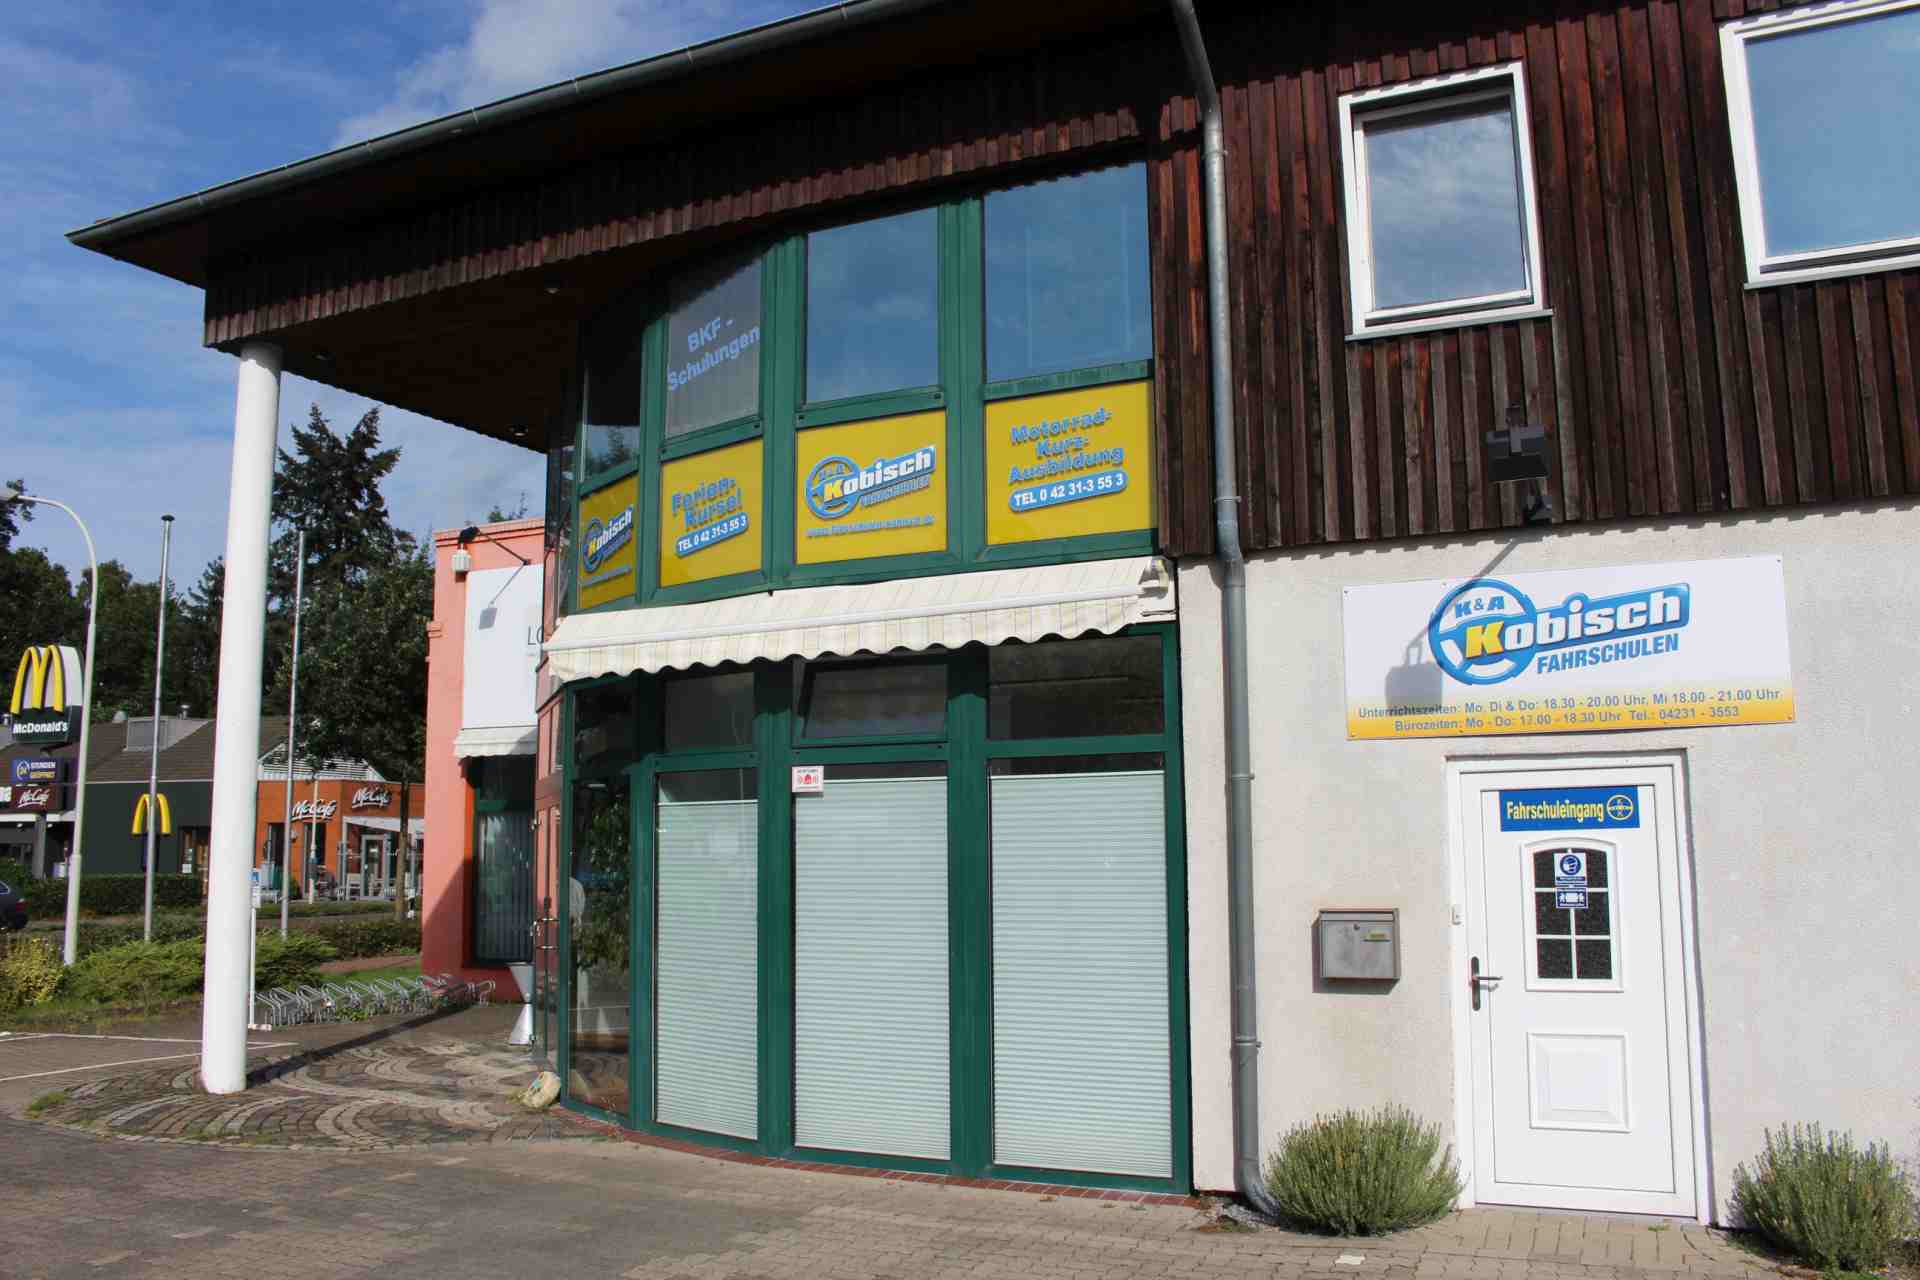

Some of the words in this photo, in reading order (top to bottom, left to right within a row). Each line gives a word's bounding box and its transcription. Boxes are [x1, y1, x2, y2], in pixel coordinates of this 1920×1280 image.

[688, 317, 721, 353] BKF
[668, 326, 761, 391] Schulungen
[1010, 408, 1112, 445] Motorrad-
[824, 451, 931, 503] Kobisch
[1008, 448, 1124, 485] Ausbildung
[1014, 491, 1037, 507] TEL
[1040, 488, 1047, 502] 0
[1051, 485, 1065, 499] 42
[1068, 480, 1094, 496] 31-3
[1098, 475, 1112, 490] 55
[1115, 472, 1123, 486] 3
[588, 508, 633, 557] Kobisch
[678, 538, 693, 552] TEL
[694, 534, 699, 546] 0
[700, 530, 710, 542] 42
[712, 521, 728, 539] 31-3
[730, 518, 739, 532] 55
[740, 514, 747, 527] 3
[1465, 590, 1681, 659] Kobisch
[1537, 633, 1680, 674] FAHRSCHULEN
[1359, 703, 1461, 718] Unterrichtszeiten:
[1490, 700, 1502, 712] Di
[1505, 700, 1515, 711] &
[1587, 695, 1619, 707] 20.00
[1653, 692, 1668, 704] Mi
[1600, 711, 1621, 722] Uhr
[1659, 707, 1695, 719] 04231
[1711, 706, 1738, 718] 3553
[13, 721, 69, 734] McDonald's
[1506, 799, 1604, 823] Fahrschuleingang
